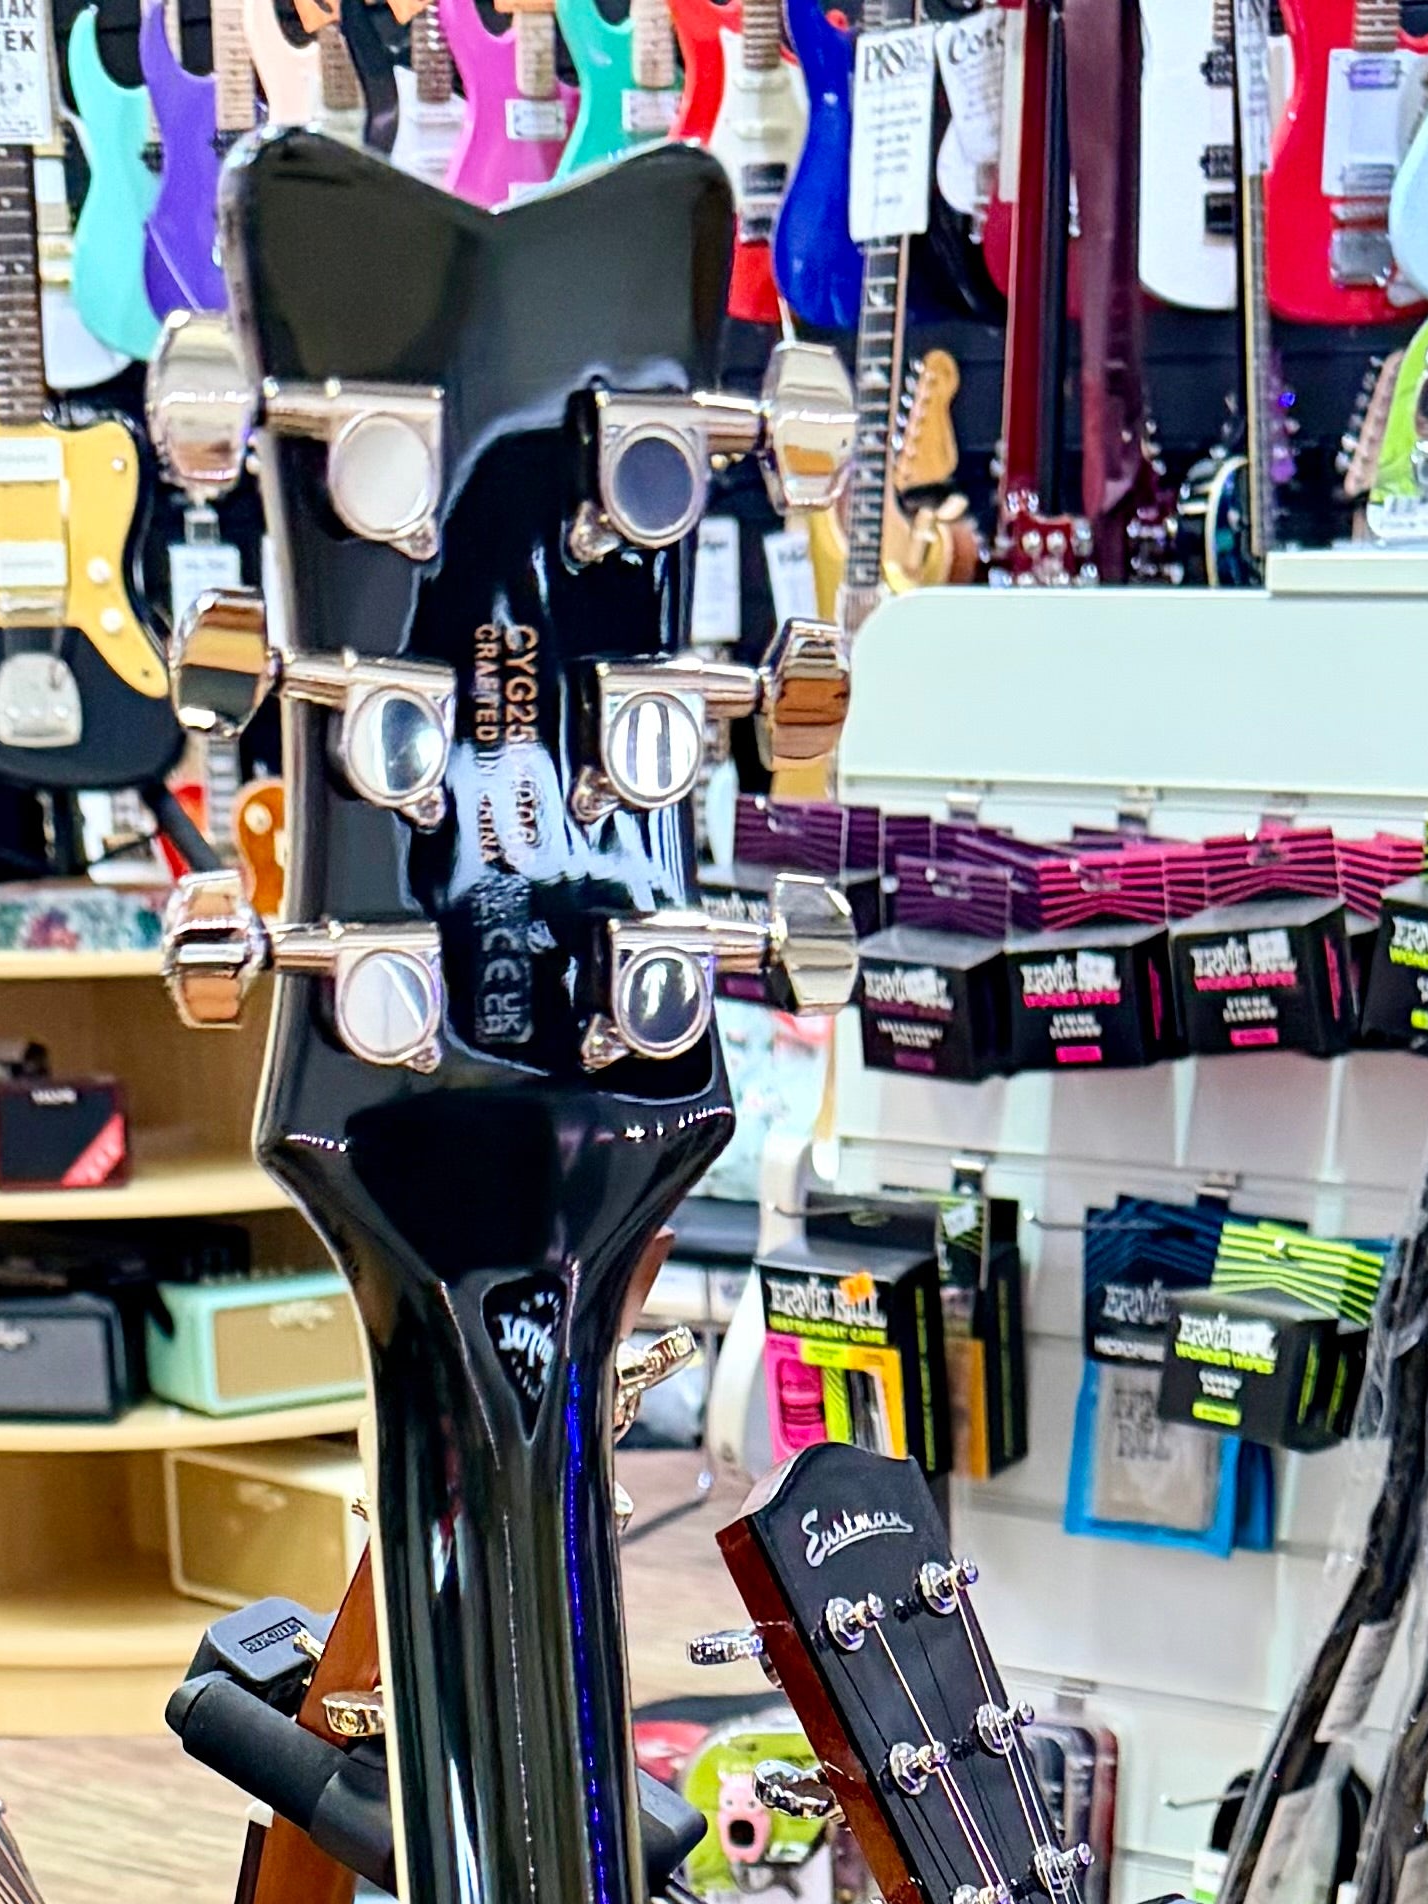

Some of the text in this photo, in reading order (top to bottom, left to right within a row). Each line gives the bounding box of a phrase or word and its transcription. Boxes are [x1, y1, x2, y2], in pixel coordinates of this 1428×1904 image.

[474, 622, 500, 742] CRAFTED
[766, 1275, 831, 1318] ERNIE
[800, 1509, 914, 1567] Eastman
